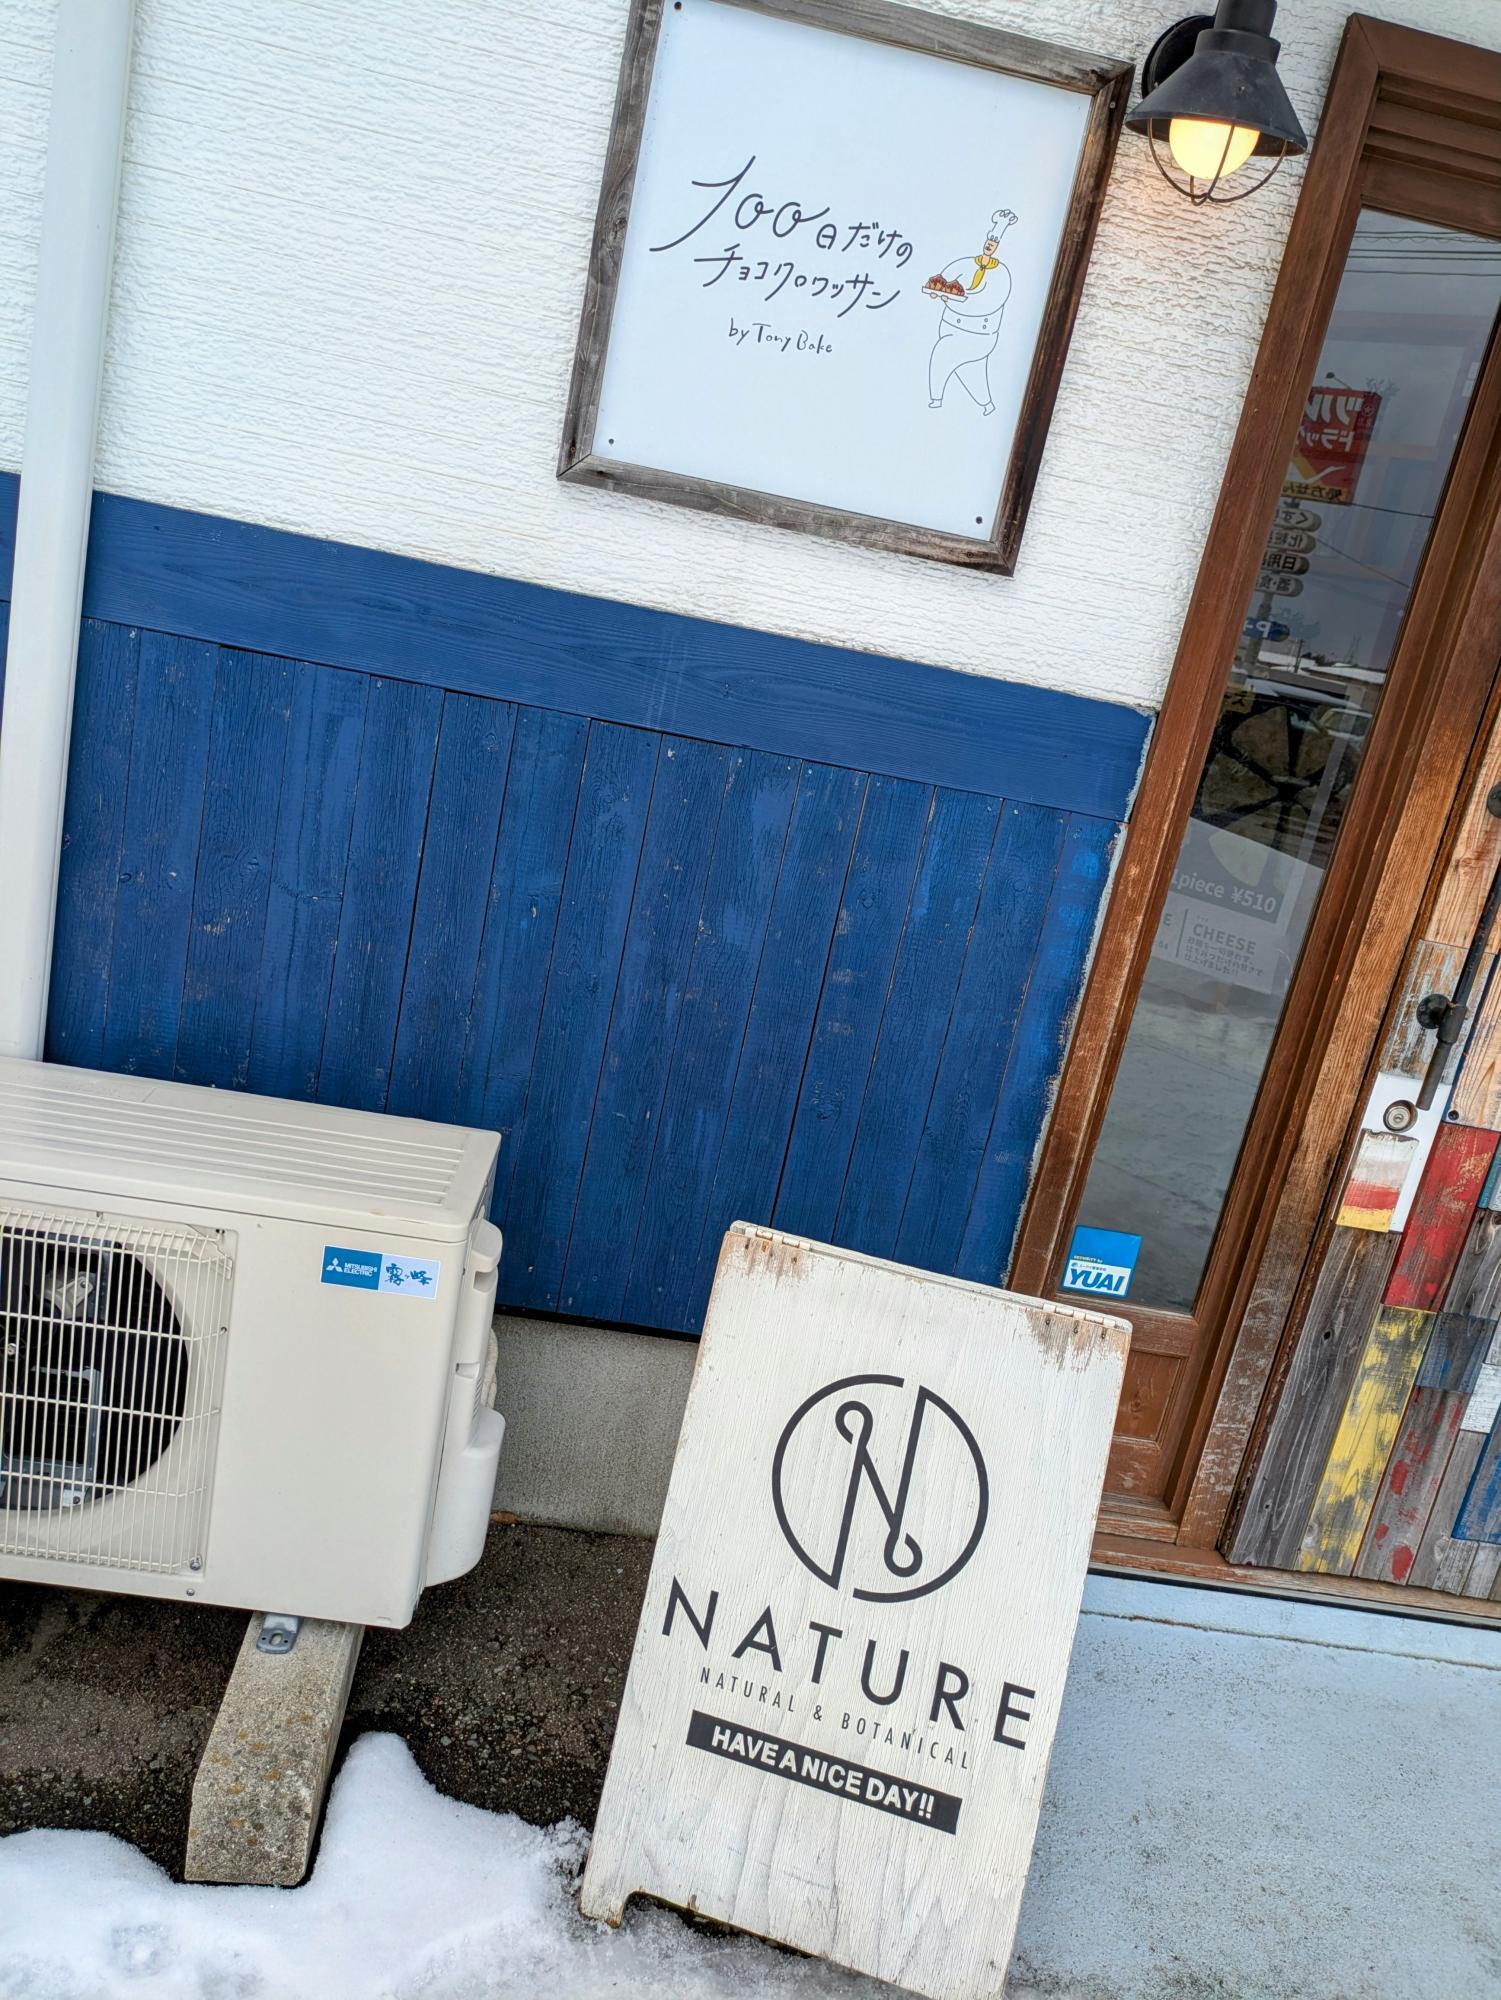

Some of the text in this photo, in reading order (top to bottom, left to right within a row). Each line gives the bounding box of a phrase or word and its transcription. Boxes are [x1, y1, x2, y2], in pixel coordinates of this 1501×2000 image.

[649, 155, 913, 269] 100日だけの
[693, 243, 901, 318] チョコクロワッサン
[728, 317, 833, 355] by Tony Bake
[1231, 886, 1277, 913] ¥510
[1193, 924, 1257, 956] CHEESE
[1070, 1267, 1126, 1292] YUAI
[661, 1575, 1037, 1751] NATURE
[699, 1665, 971, 1770] NATURAL & BOTANICAL
[711, 1724, 935, 1821] HAVE A NICE DAY!!
